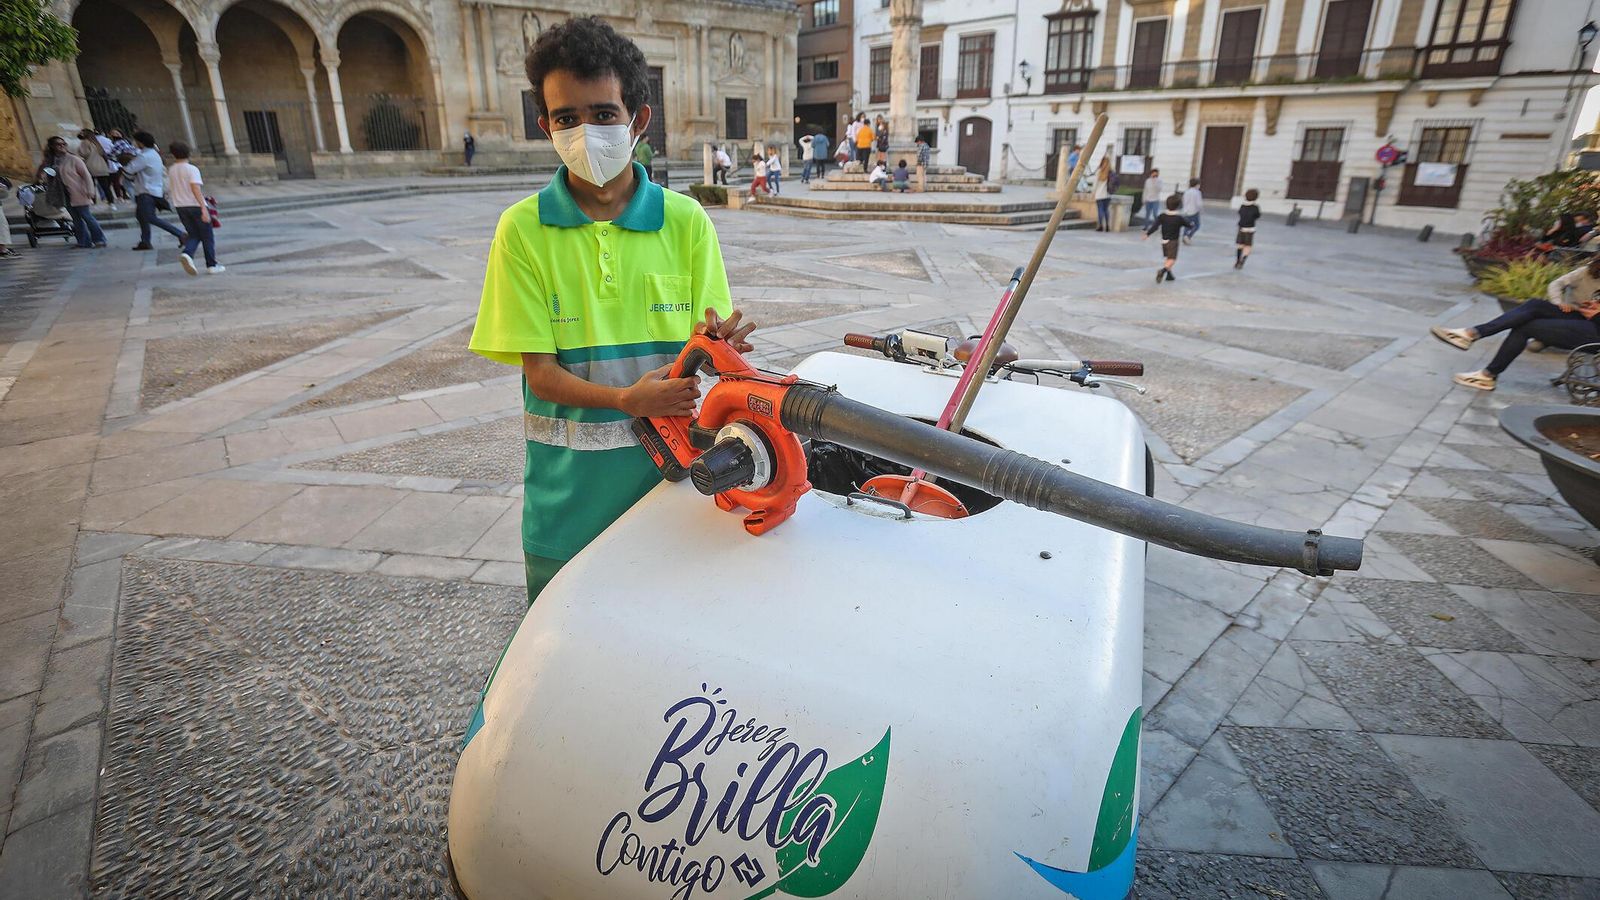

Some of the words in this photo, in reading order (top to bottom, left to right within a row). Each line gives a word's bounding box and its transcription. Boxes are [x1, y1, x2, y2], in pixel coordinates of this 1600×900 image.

[649, 303, 673, 312] JEREZ
[675, 303, 690, 312] UTE
[704, 709, 788, 761] Jerez
[637, 697, 834, 863] Brilla
[596, 812, 727, 900] Contigo
